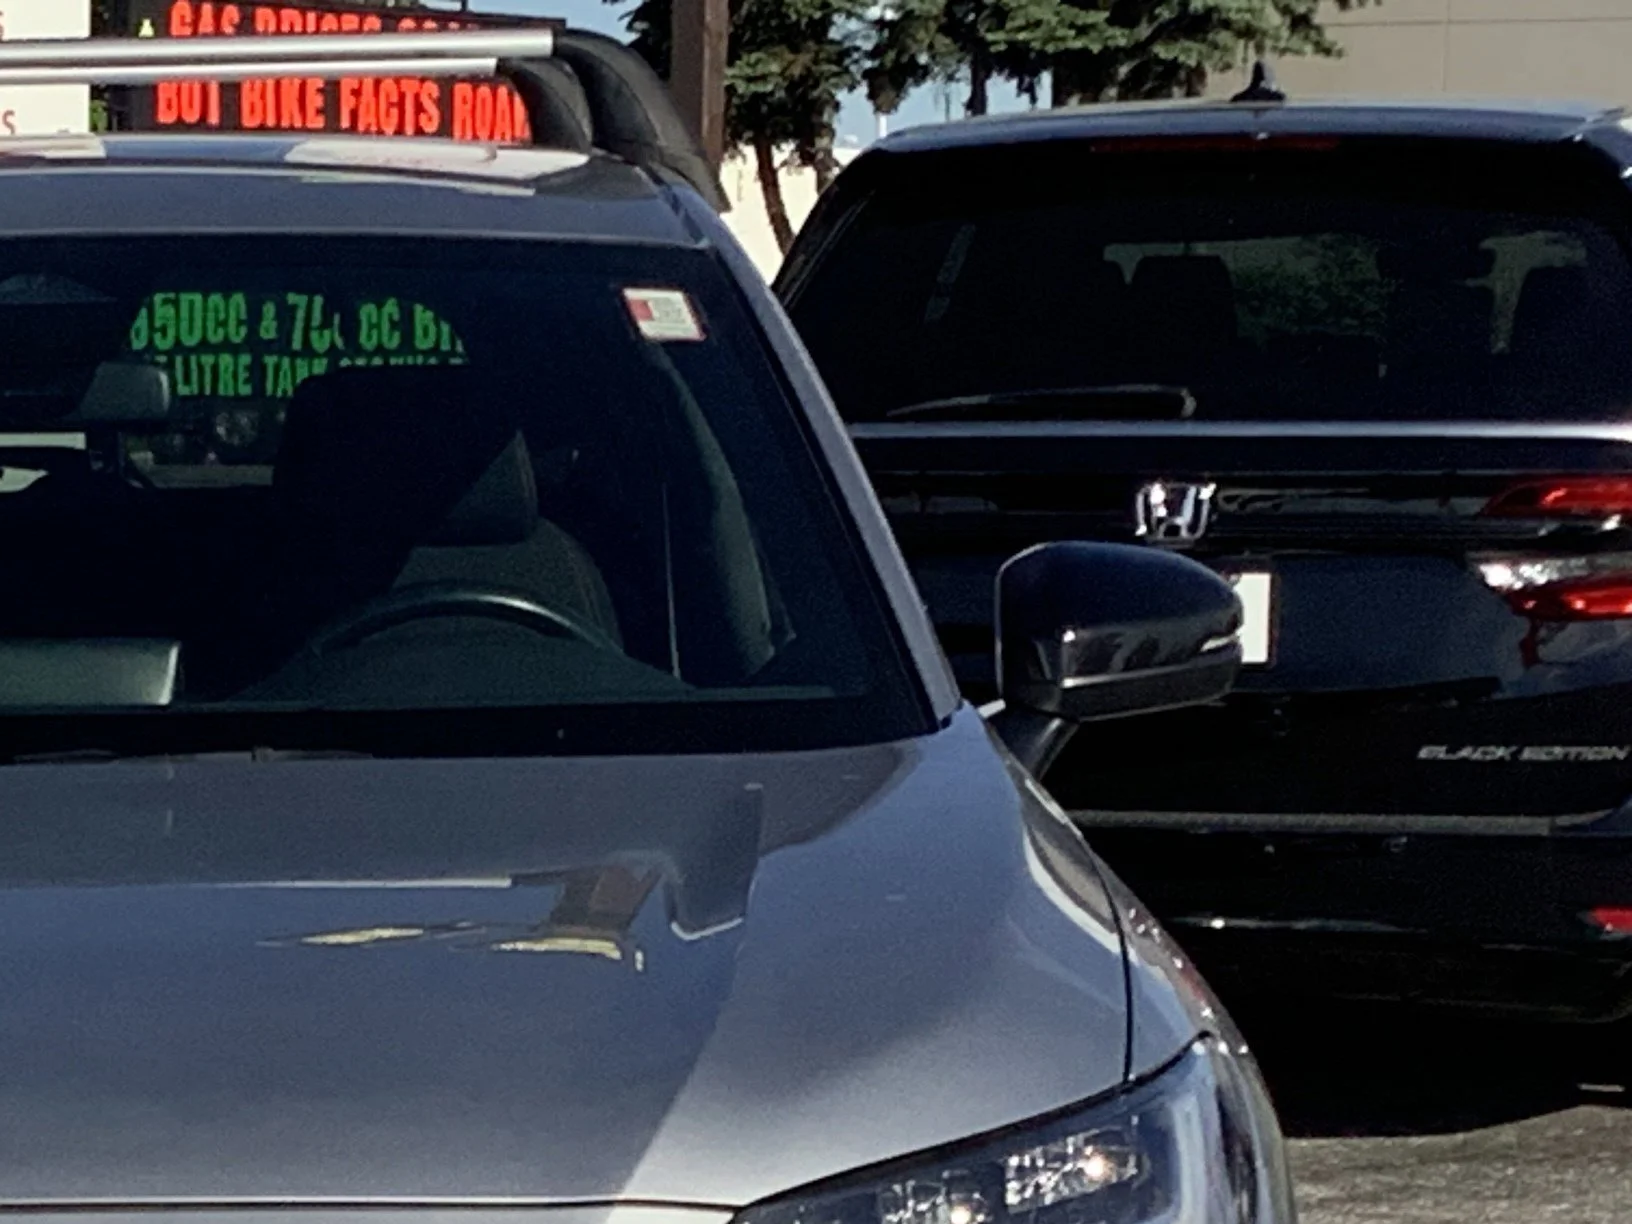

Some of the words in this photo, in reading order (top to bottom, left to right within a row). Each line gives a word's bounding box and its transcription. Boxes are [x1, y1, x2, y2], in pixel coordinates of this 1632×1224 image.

[240, 77, 325, 129] BIKE
[339, 76, 441, 136] FACTS
[358, 298, 402, 351] CC
[174, 354, 253, 397] LITRE
[1417, 744, 1517, 761] BLACK
